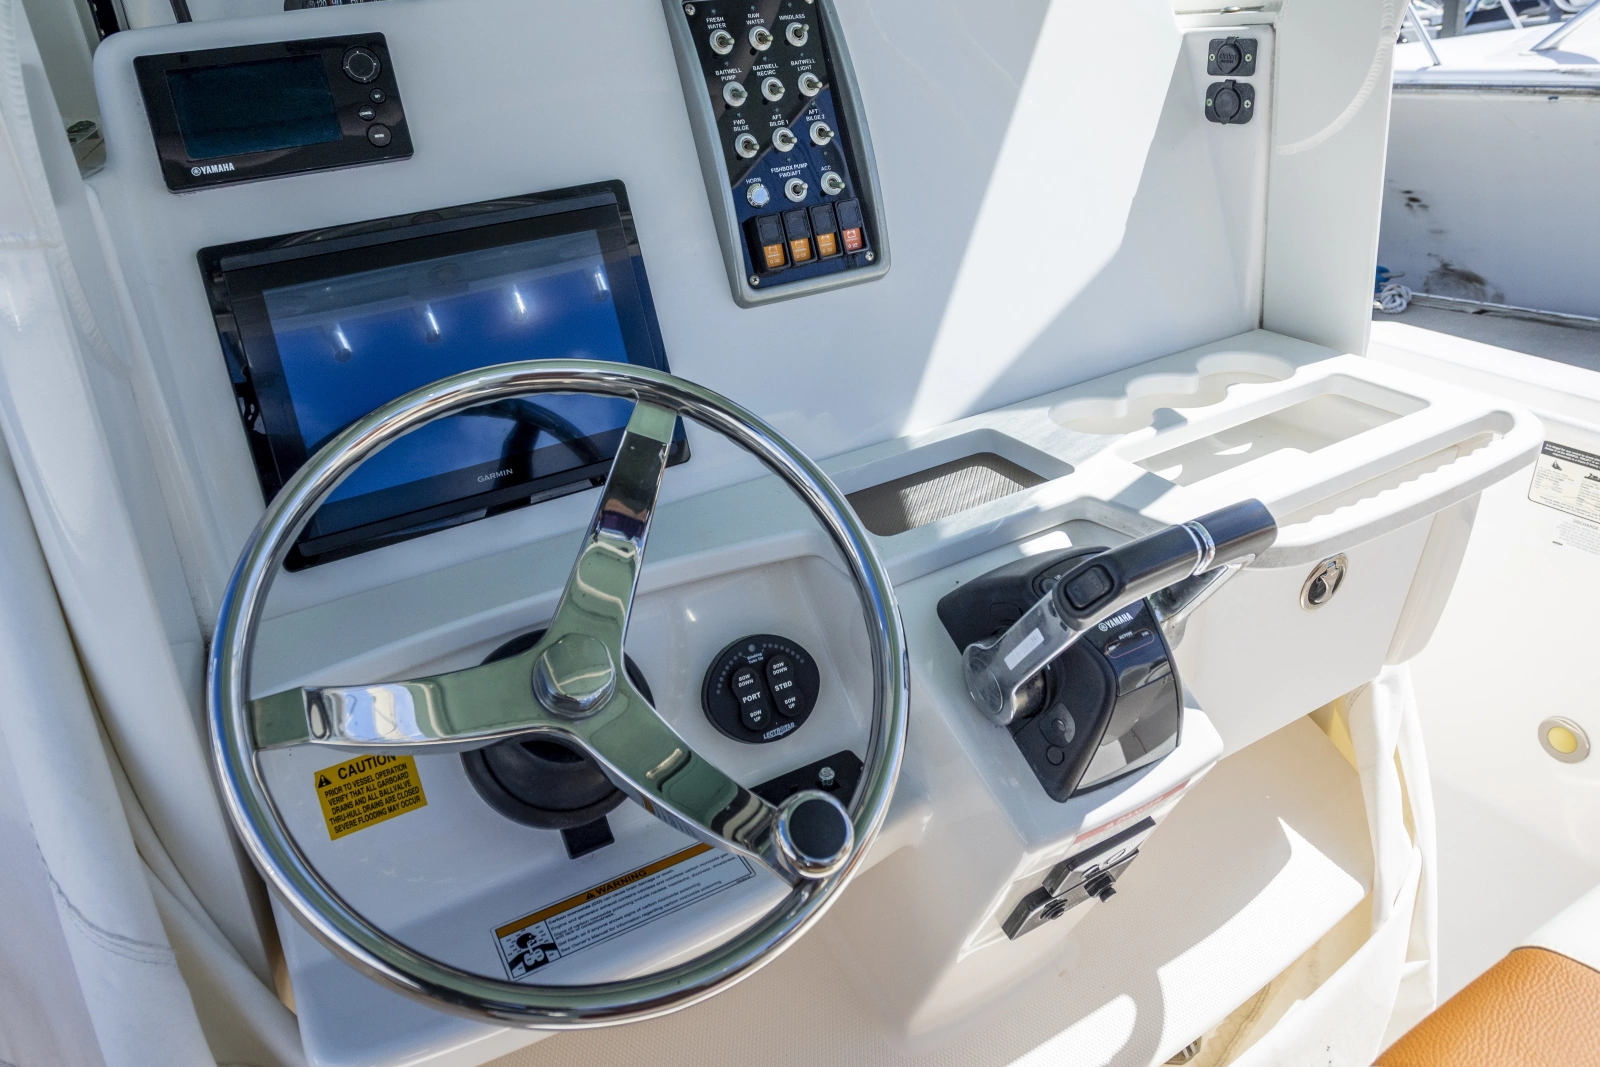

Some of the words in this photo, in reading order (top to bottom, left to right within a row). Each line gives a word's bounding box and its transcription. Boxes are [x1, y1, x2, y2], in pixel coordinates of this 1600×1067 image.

[715, 68, 742, 76] BAITWELL
[201, 162, 235, 175] YAMAHA
[771, 165, 792, 174] FISHBOX
[478, 468, 513, 482] GARMIN
[1106, 612, 1133, 628] YAMAHA
[773, 667, 787, 675] DOWN
[739, 679, 753, 687] DOWN
[775, 681, 792, 691] STBD
[742, 692, 760, 703] PORT
[338, 756, 396, 779] CAUTION
[325, 786, 343, 798] PRIOR
[343, 782, 351, 790] TO
[352, 776, 374, 787] VESSEL
[375, 763, 407, 780] OPERATION
[328, 794, 348, 806] VERIFY
[350, 789, 364, 798] THAT
[366, 784, 376, 792] ALL
[377, 772, 409, 788] GARBOARD
[332, 803, 354, 815] DRAINS
[355, 798, 367, 807] AND
[368, 793, 378, 801] ALL
[380, 780, 411, 797] BALLVALVE
[329, 809, 362, 825] THRU-HULL
[363, 800, 384, 813] DRAINS
[385, 795, 396, 804] ARE
[397, 787, 419, 800] CLOSED
[334, 821, 357, 833] SEVERE
[358, 809, 387, 824] FLOODING
[388, 803, 400, 813] MAY
[401, 796, 421, 808] OCCUR
[595, 870, 647, 895] WARNING
